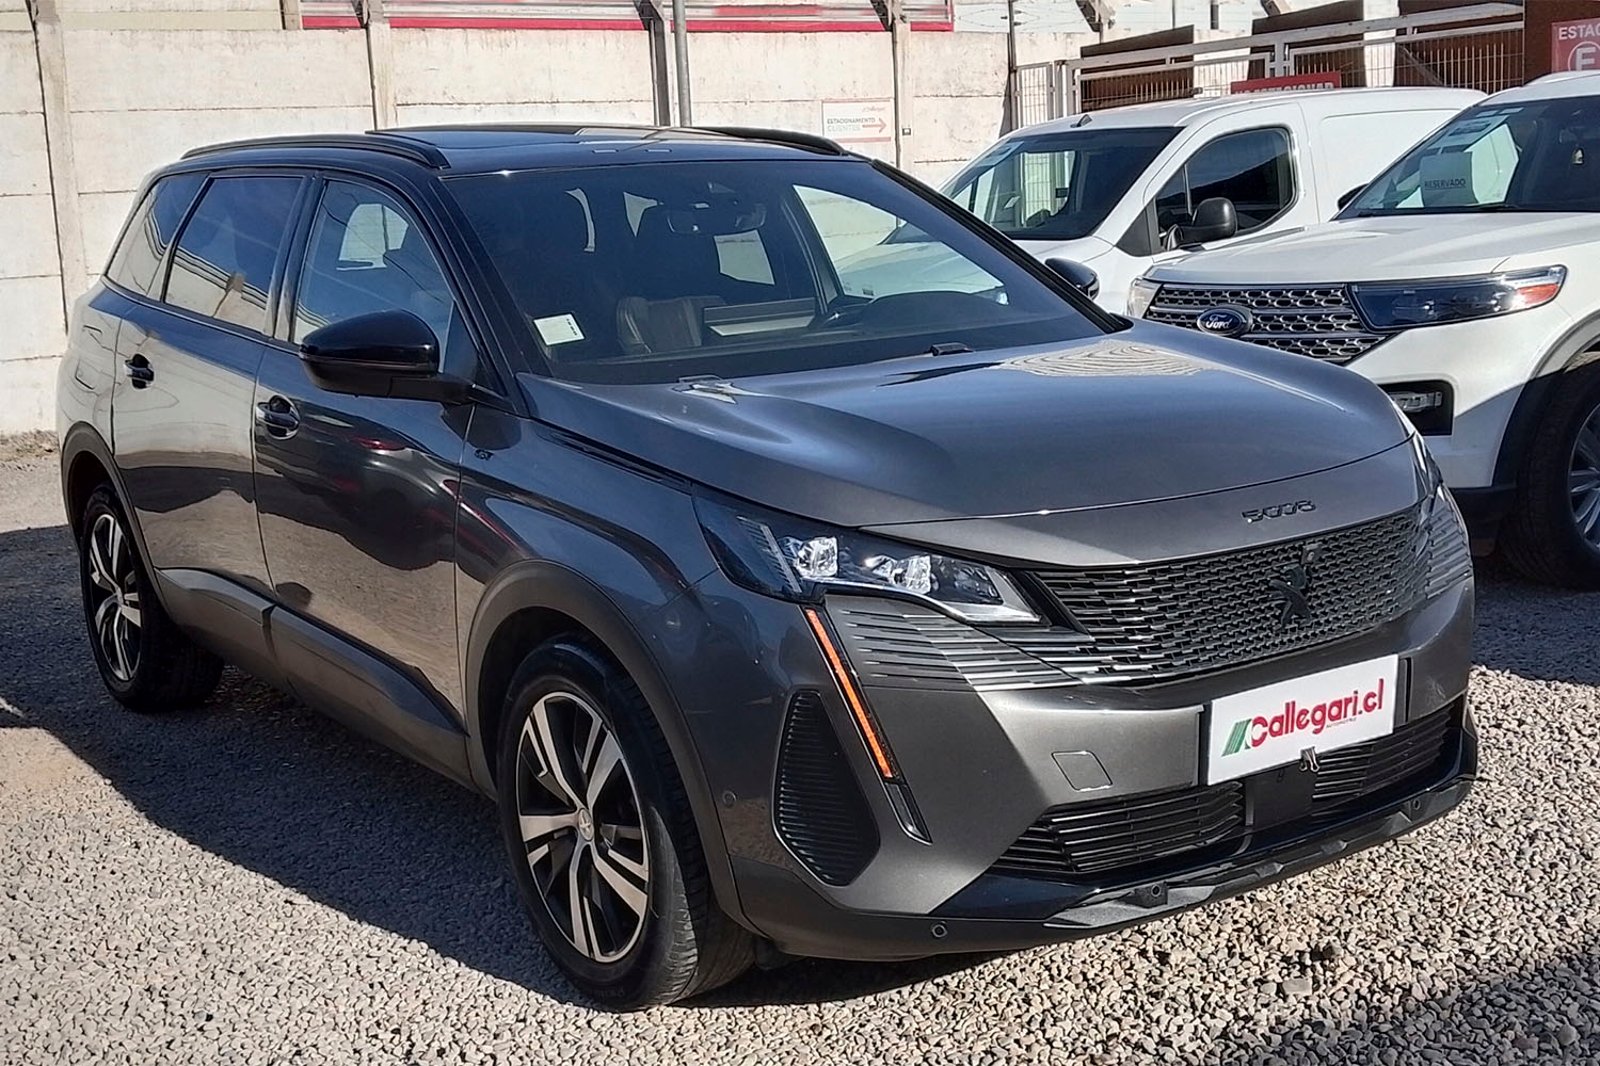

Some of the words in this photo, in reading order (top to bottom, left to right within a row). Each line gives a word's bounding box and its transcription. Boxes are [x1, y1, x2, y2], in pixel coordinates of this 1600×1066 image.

[1424, 178, 1466, 188] RESERVADO
[1205, 313, 1233, 328] Ford
[1242, 500, 1316, 522] 5008
[1250, 678, 1385, 748] Callegari.cl
